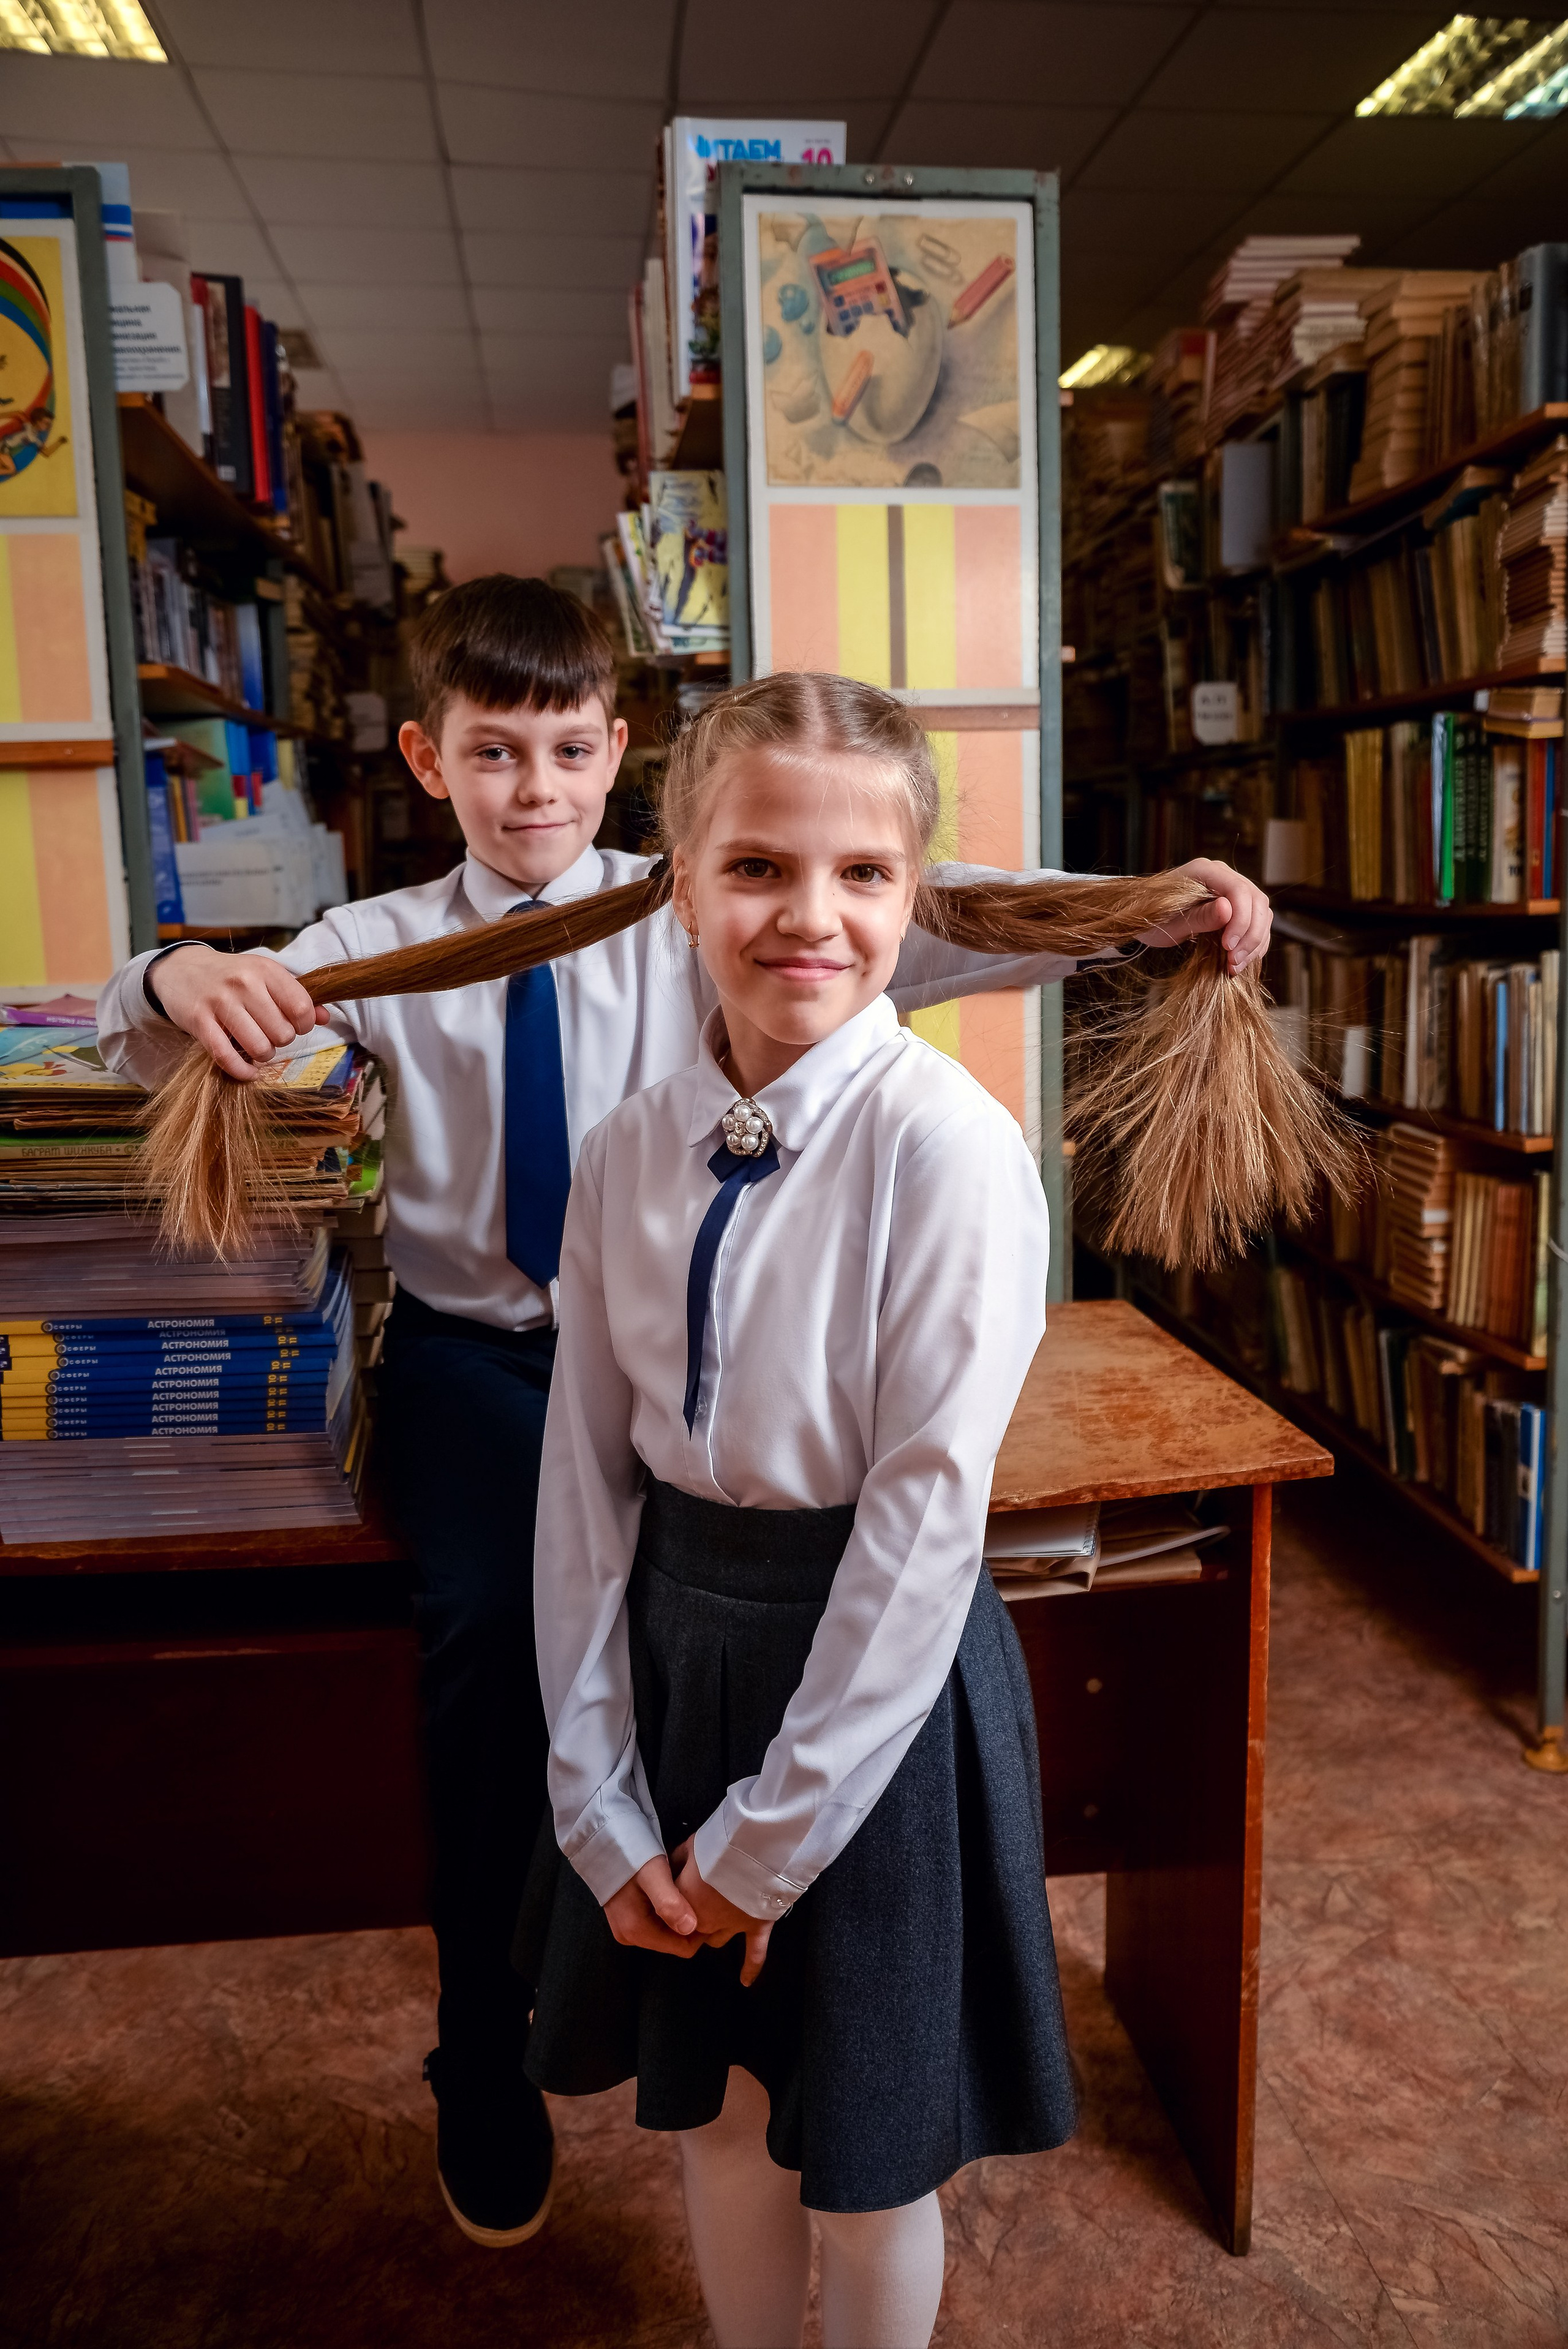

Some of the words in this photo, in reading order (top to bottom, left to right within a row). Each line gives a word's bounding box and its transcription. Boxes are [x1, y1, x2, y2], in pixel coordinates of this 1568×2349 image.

[46, 1016, 75, 1025] ENGLISH
[22, 1147, 60, 1157] БАГРАТ
[64, 1145, 113, 1156] ШИНКУБА
[148, 1319, 214, 1329] АСТРОНОМИЯ
[159, 1329, 225, 1338] АСТРОНОМИЯ
[162, 1340, 228, 1349] АСТРОНОМИЯ
[164, 1353, 231, 1362] АСТРОНОМИЯ
[155, 1365, 222, 1375] АСТРОНОМИЯ
[153, 1379, 219, 1389] АСТРОНОМИЯ
[153, 1391, 219, 1400] АСТРОНОМИЯ
[152, 1402, 219, 1411] АСТРОНОМИЯ
[152, 1414, 218, 1423] АСТРОНОМИЯ
[152, 1426, 218, 1435] АСТРОНОМИЯ
